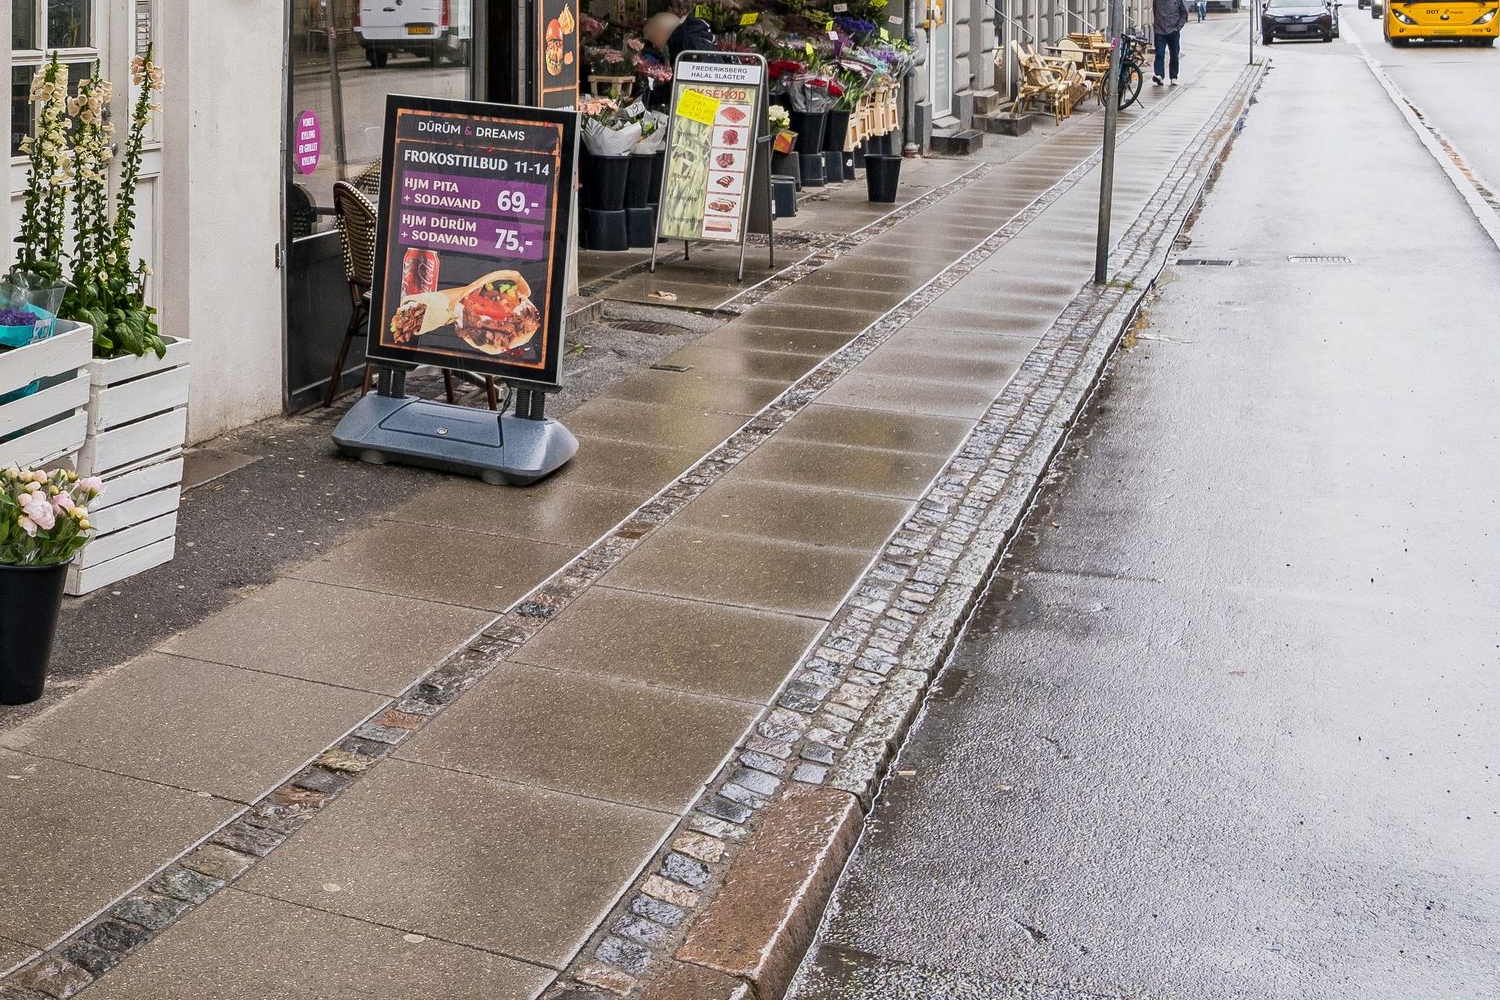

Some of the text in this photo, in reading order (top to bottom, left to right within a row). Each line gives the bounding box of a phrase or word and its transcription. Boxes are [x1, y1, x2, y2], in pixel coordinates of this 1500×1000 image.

[692, 65, 748, 74] FREDERIKSBERG
[418, 121, 525, 141] DÜRÜM & DREAMS
[404, 150, 550, 176] FROKOSTTILBUD 11-14
[404, 177, 459, 193] HJM PITA
[414, 194, 481, 210] SODAVAND
[497, 190, 539, 215] 69,-
[402, 214, 477, 232] HJM DÜRÜM
[412, 230, 479, 247] SODAVAND
[494, 228, 533, 254] 75,-
